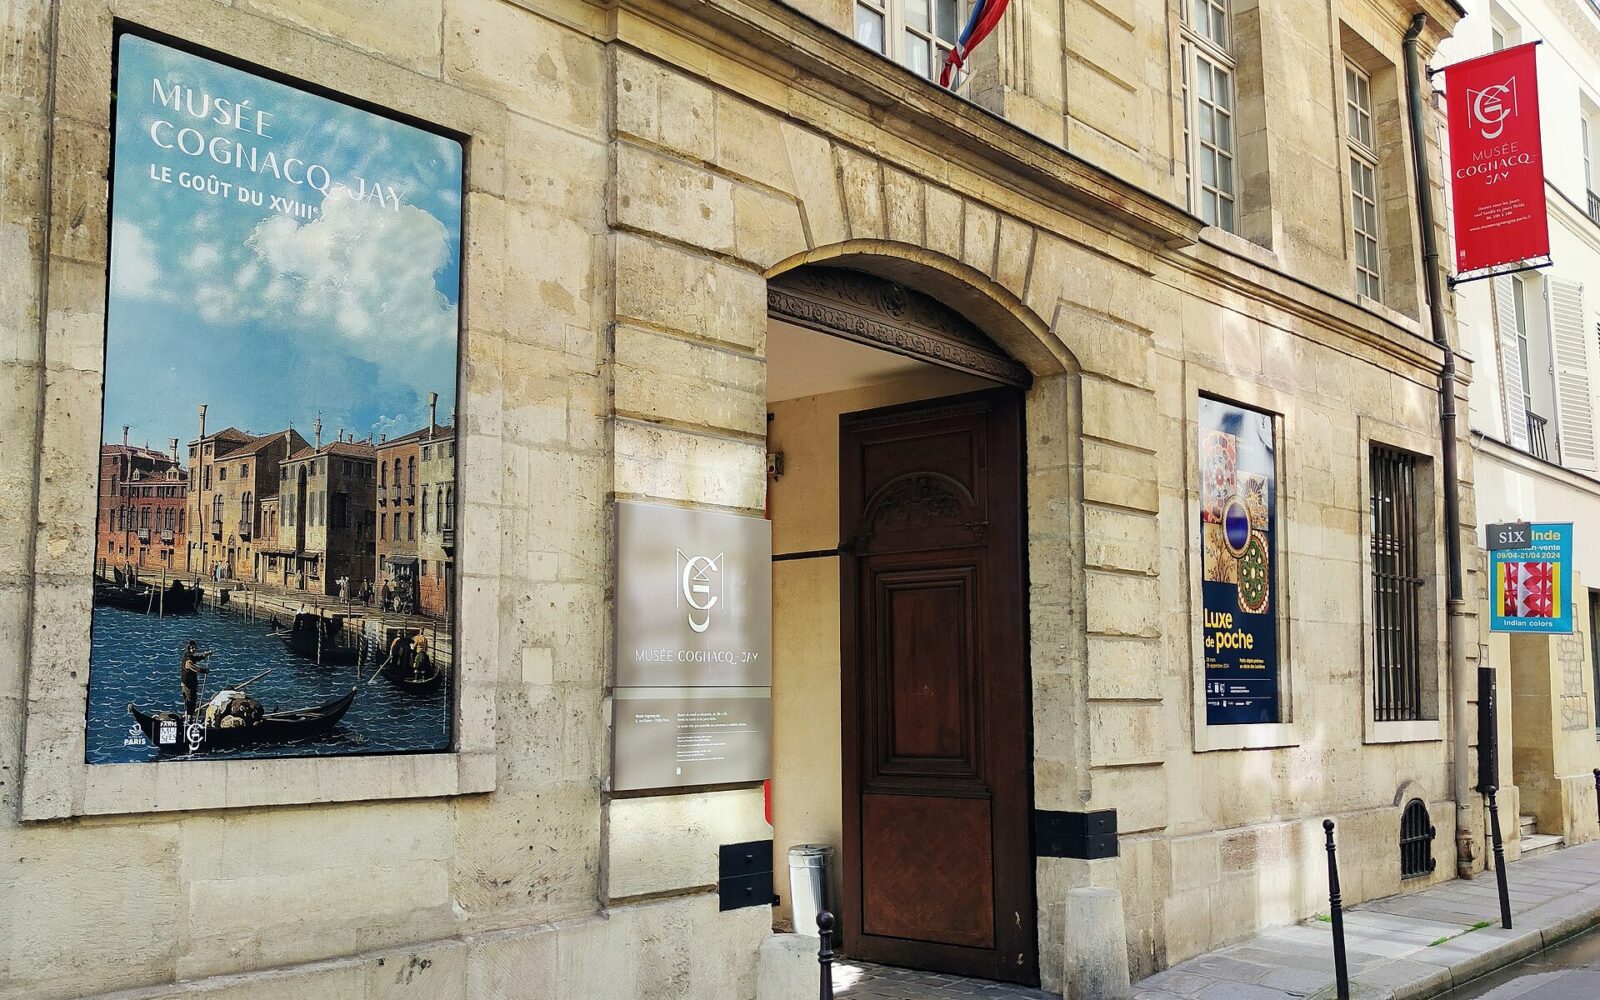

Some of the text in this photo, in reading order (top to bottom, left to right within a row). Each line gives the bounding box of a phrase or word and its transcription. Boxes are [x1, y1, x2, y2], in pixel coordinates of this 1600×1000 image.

[152, 78, 274, 138] MUSÉE
[1472, 142, 1518, 161] MUSÉE
[150, 120, 406, 212] COGNACQ-JAY
[1456, 153, 1537, 178] COGNACQ-
[150, 164, 172, 184] LE
[179, 172, 232, 198] GOÛT
[238, 187, 263, 207] DU
[1486, 171, 1509, 185] JAY
[1499, 526, 1525, 544] six
[1531, 530, 1560, 541] Inde
[1204, 608, 1232, 628] Luxe
[1205, 628, 1254, 654] de poche
[635, 647, 673, 662] MUSÉE
